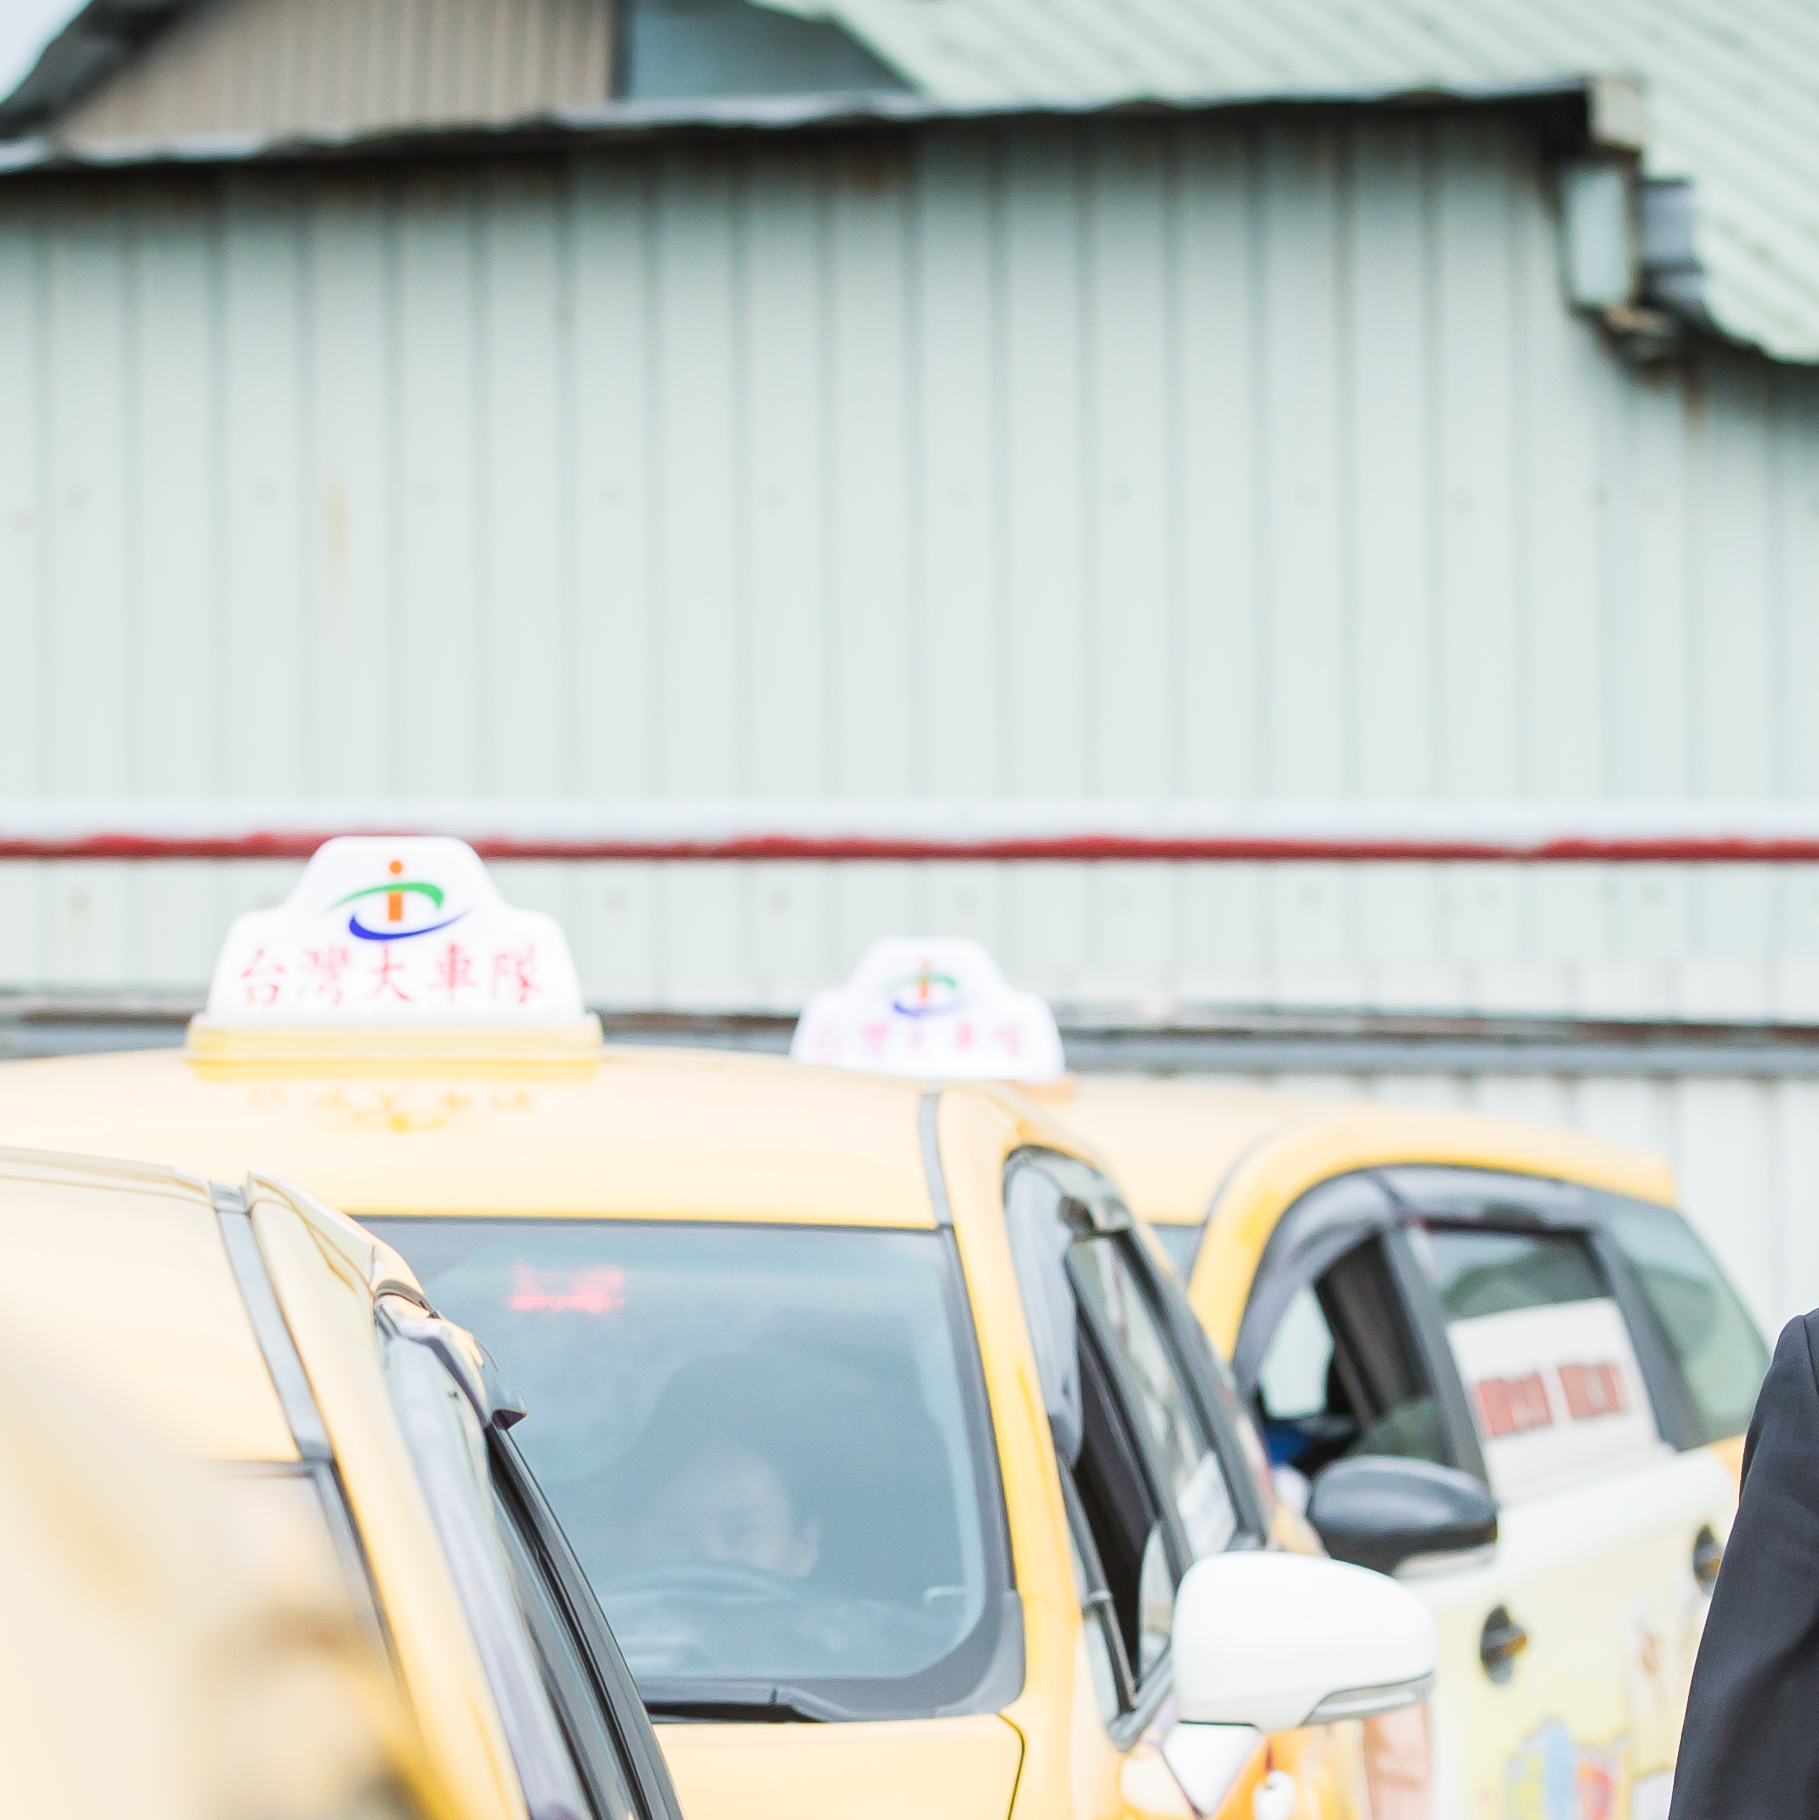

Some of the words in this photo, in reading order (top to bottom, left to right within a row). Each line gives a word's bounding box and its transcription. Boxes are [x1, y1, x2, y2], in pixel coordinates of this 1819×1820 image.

[241, 942, 542, 1005] 台灣大車隊
